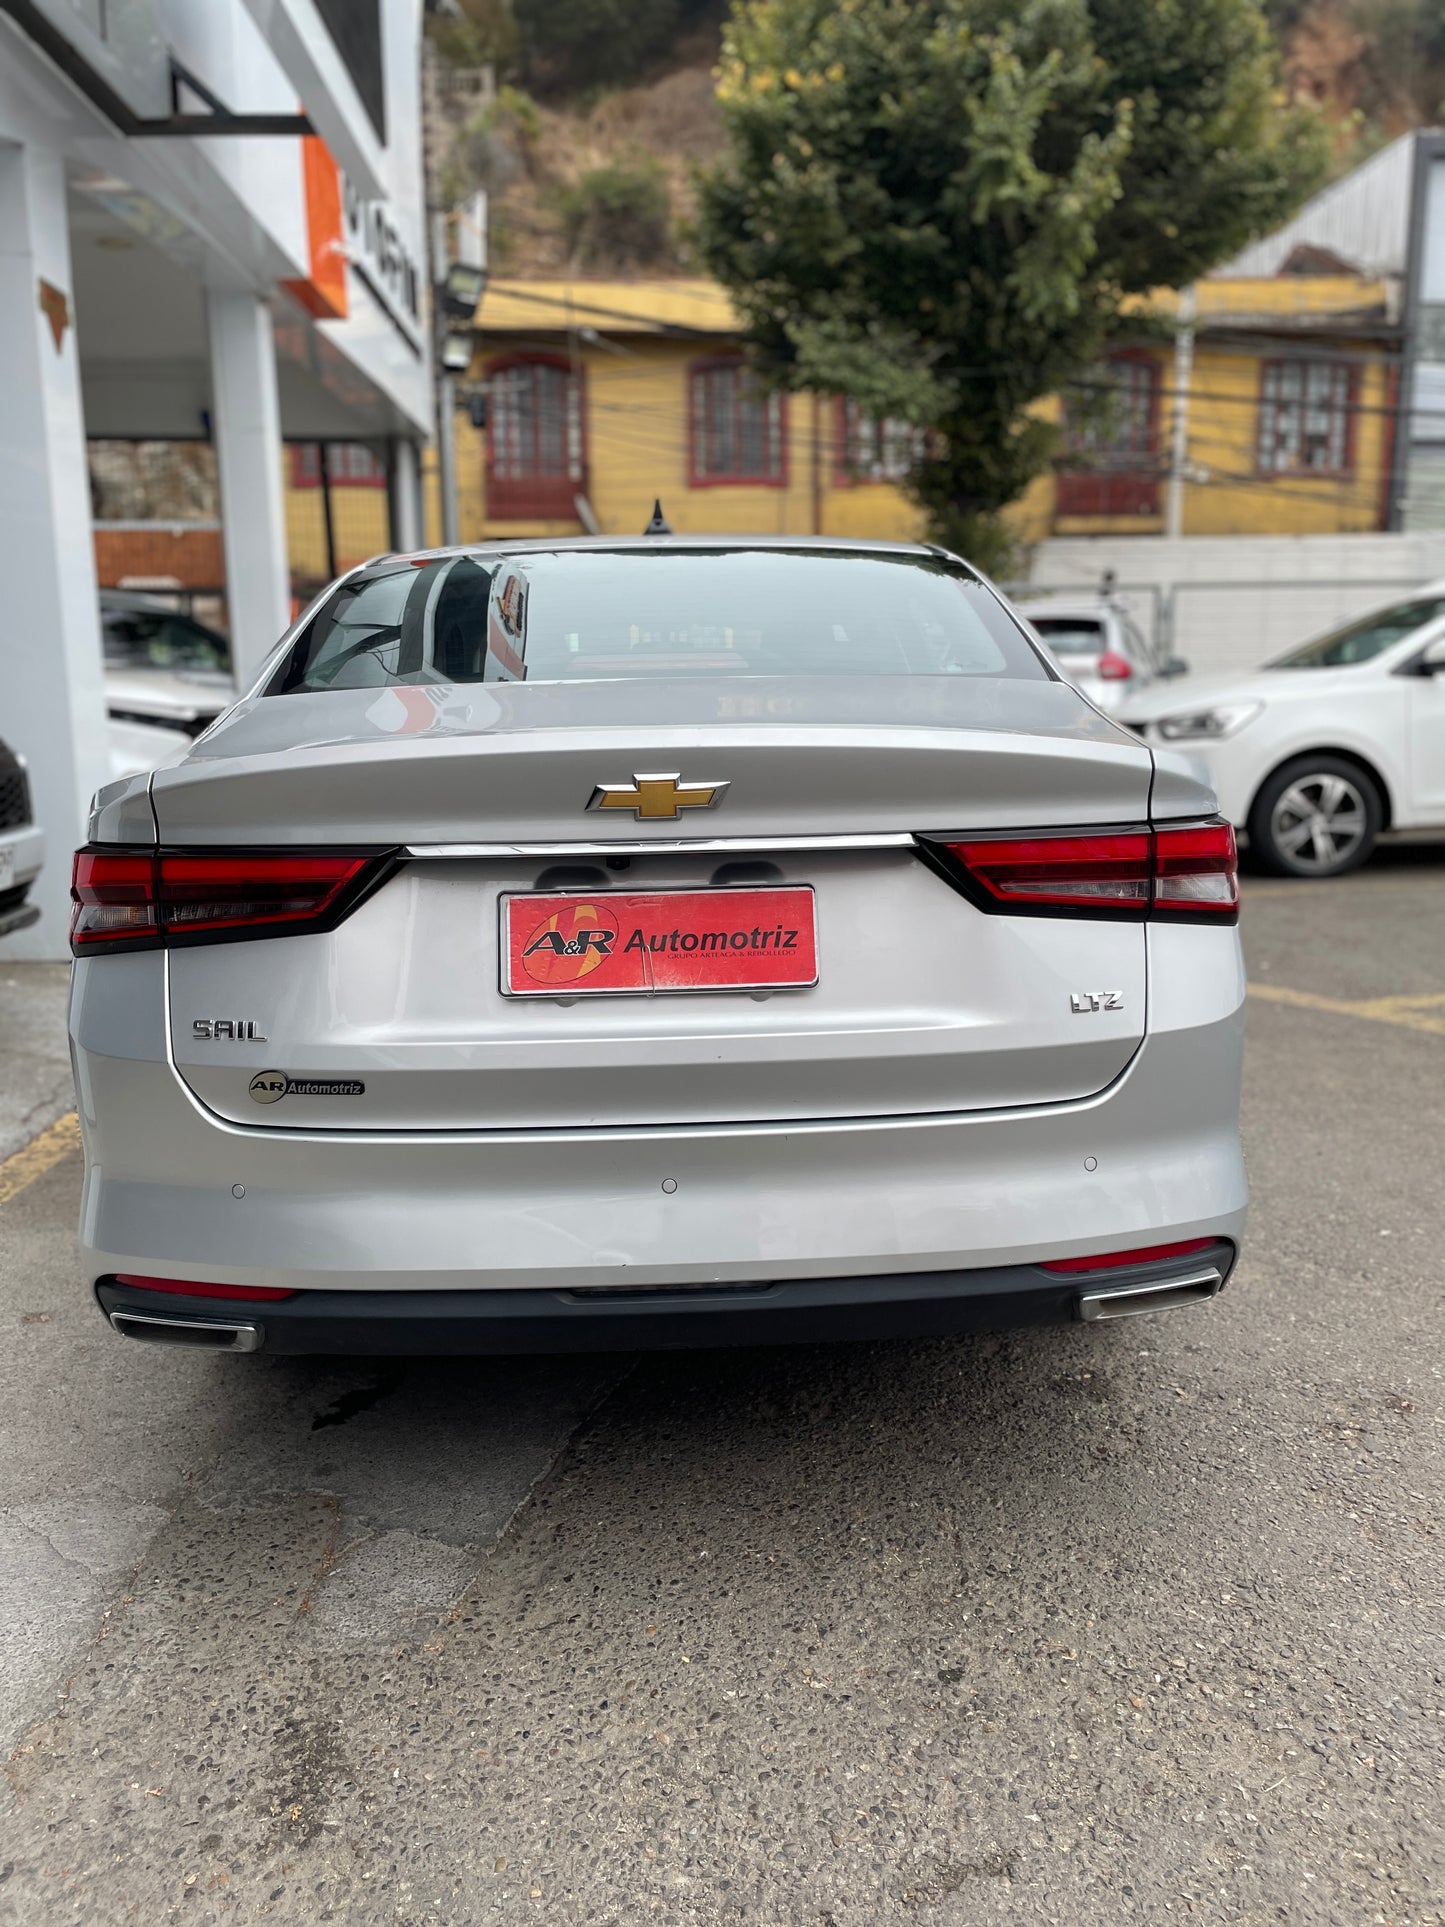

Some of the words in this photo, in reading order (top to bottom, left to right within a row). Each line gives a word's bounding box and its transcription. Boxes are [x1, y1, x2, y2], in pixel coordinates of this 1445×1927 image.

[522, 929, 615, 957] A&R
[623, 924, 798, 953] Automotriz
[700, 951, 737, 959] ARTEAGA
[747, 949, 796, 957] REBOLLEDO
[1070, 990, 1124, 1014] LTZ
[193, 1019, 268, 1042] SAIL
[250, 1081, 285, 1092] AR
[287, 1081, 361, 1095] Automotriz
